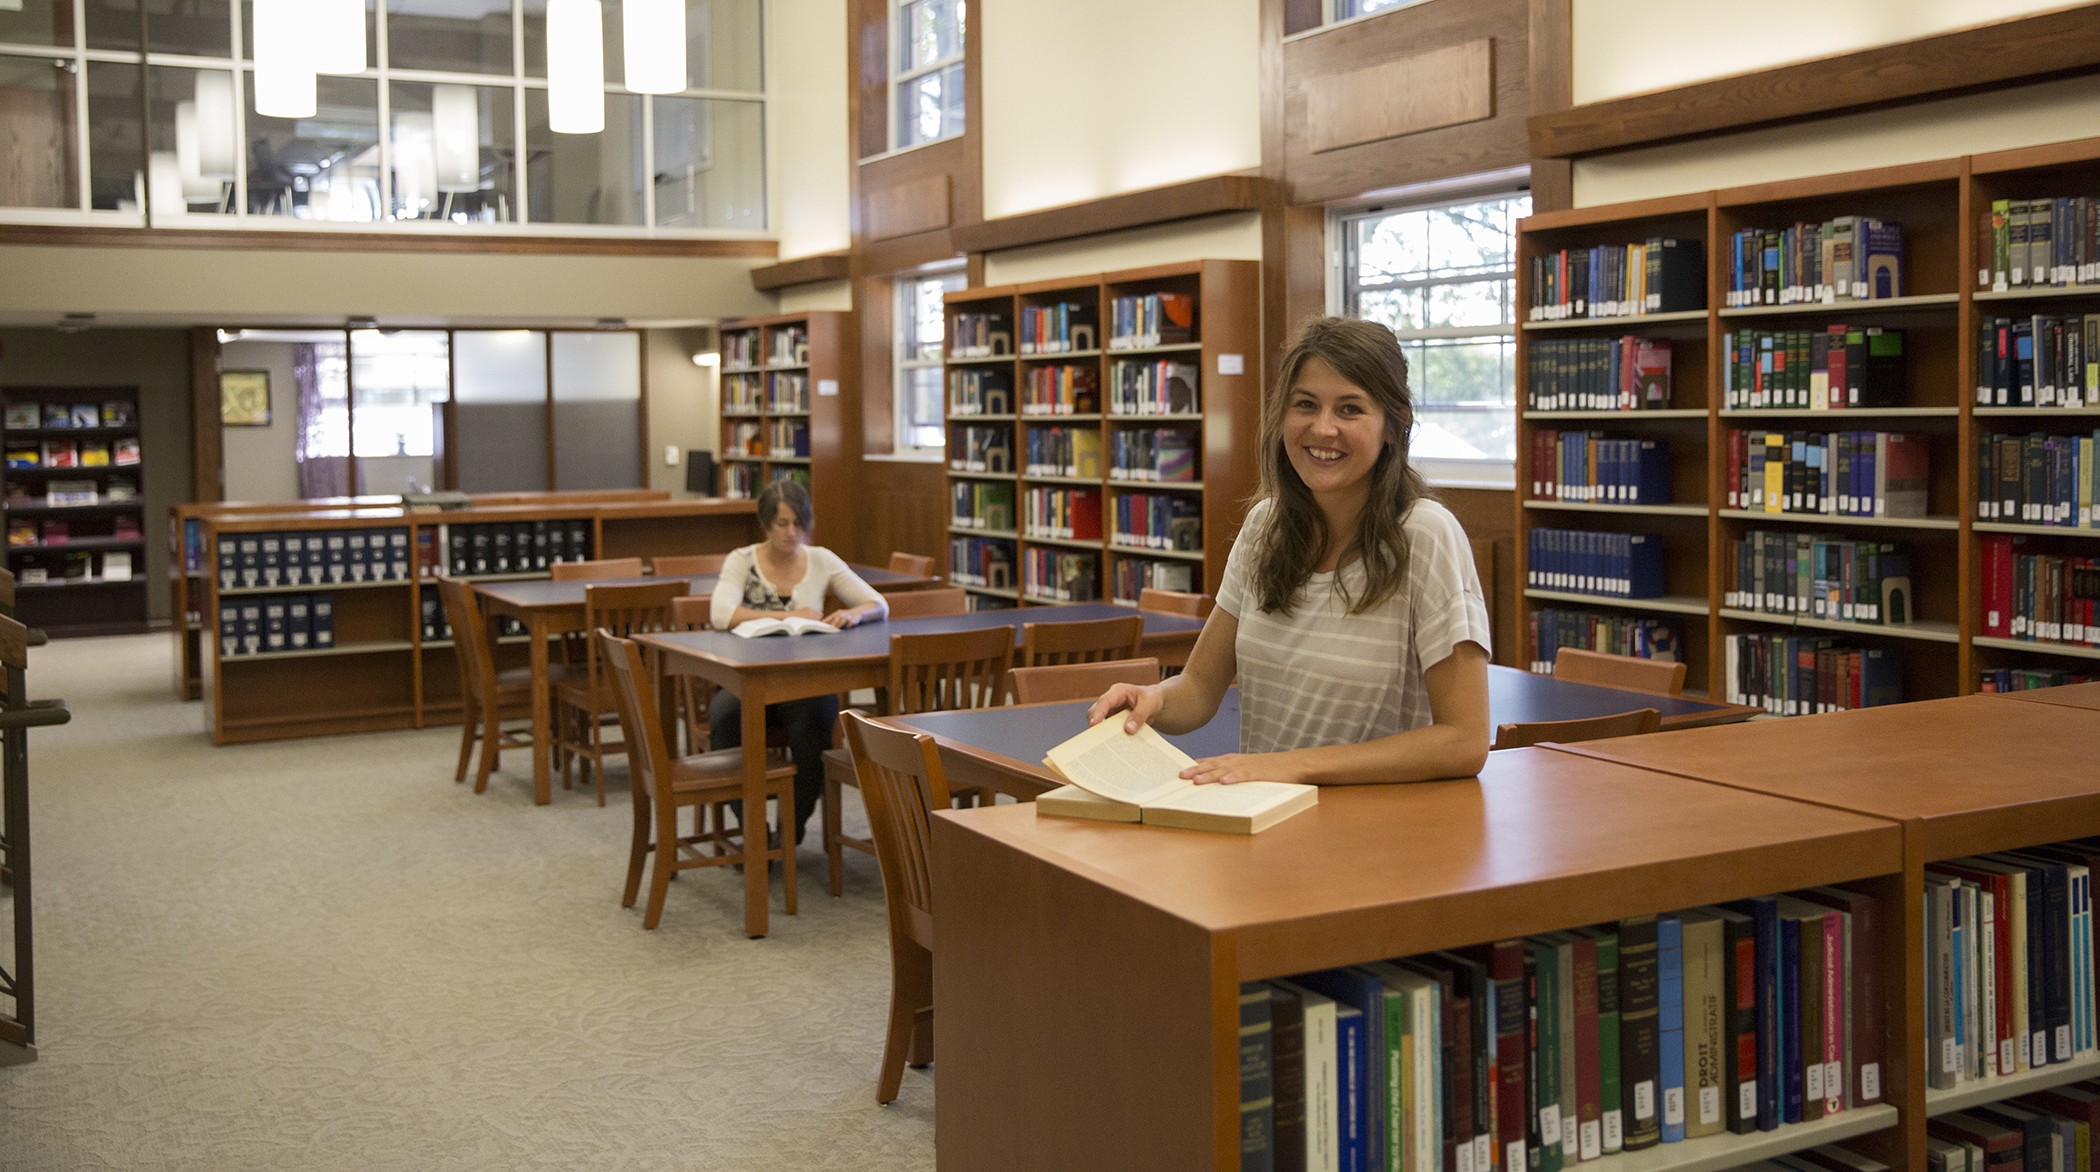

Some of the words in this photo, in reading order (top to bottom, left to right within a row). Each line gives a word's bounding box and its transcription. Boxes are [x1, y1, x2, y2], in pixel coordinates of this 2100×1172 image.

[1708, 994, 1719, 1084] ADMINISTRATIF
[1390, 1050, 1400, 1087] Putting
[1698, 1043, 1709, 1087] DROIT
[1391, 1088, 1400, 1105] the
